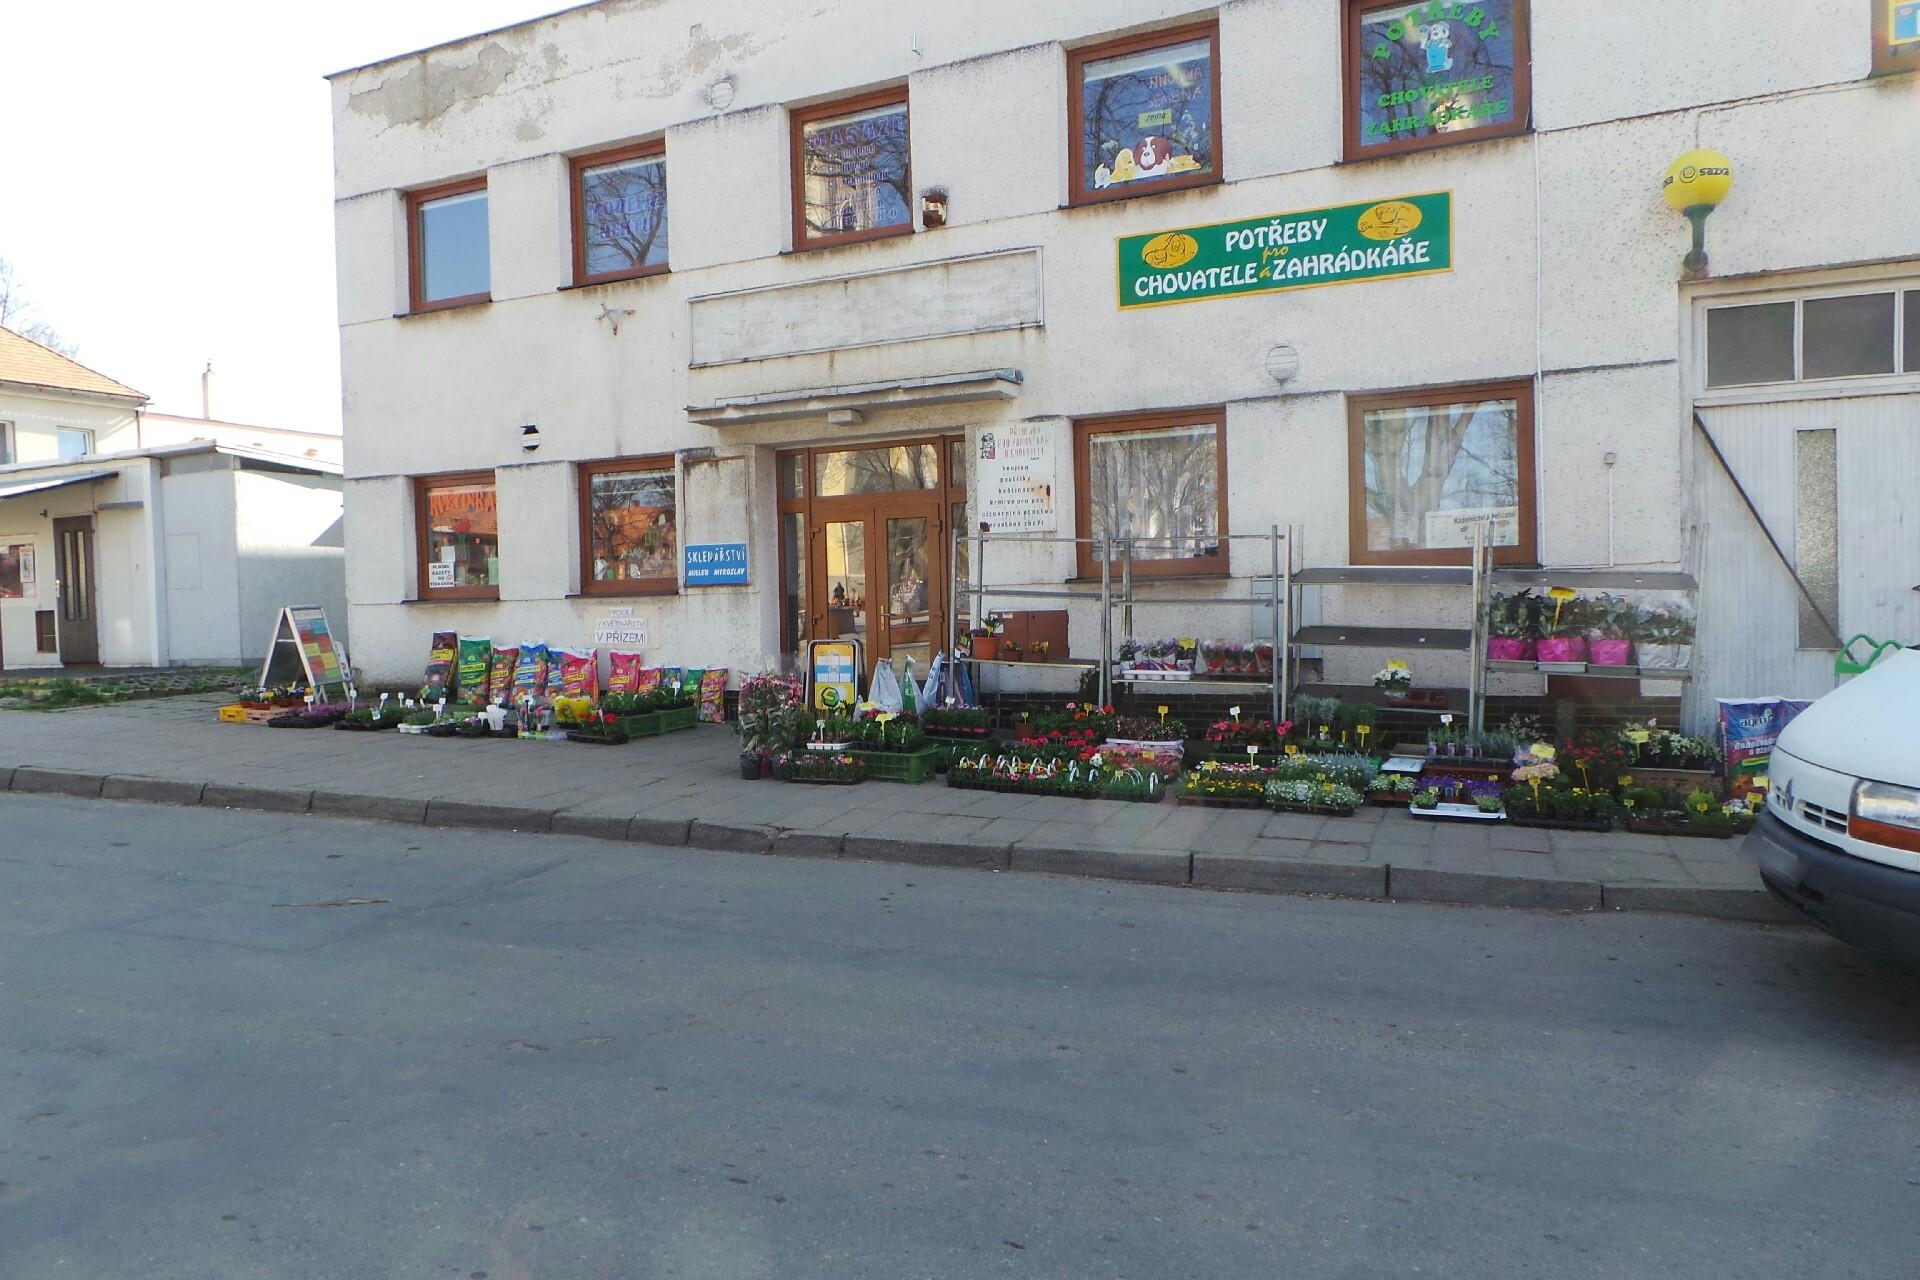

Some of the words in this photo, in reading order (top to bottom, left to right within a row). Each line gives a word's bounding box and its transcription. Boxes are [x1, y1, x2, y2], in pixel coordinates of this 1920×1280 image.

[1225, 218, 1328, 252] POTŘEBY
[1262, 244, 1289, 265] pro
[1134, 262, 1258, 298] CHOVATELE
[1271, 237, 1430, 281] ZAHRÁDKÁŘE
[687, 547, 746, 564] SKLENÁŘSTVÍ
[713, 567, 746, 576] MIROSLAV
[596, 632, 604, 642] V
